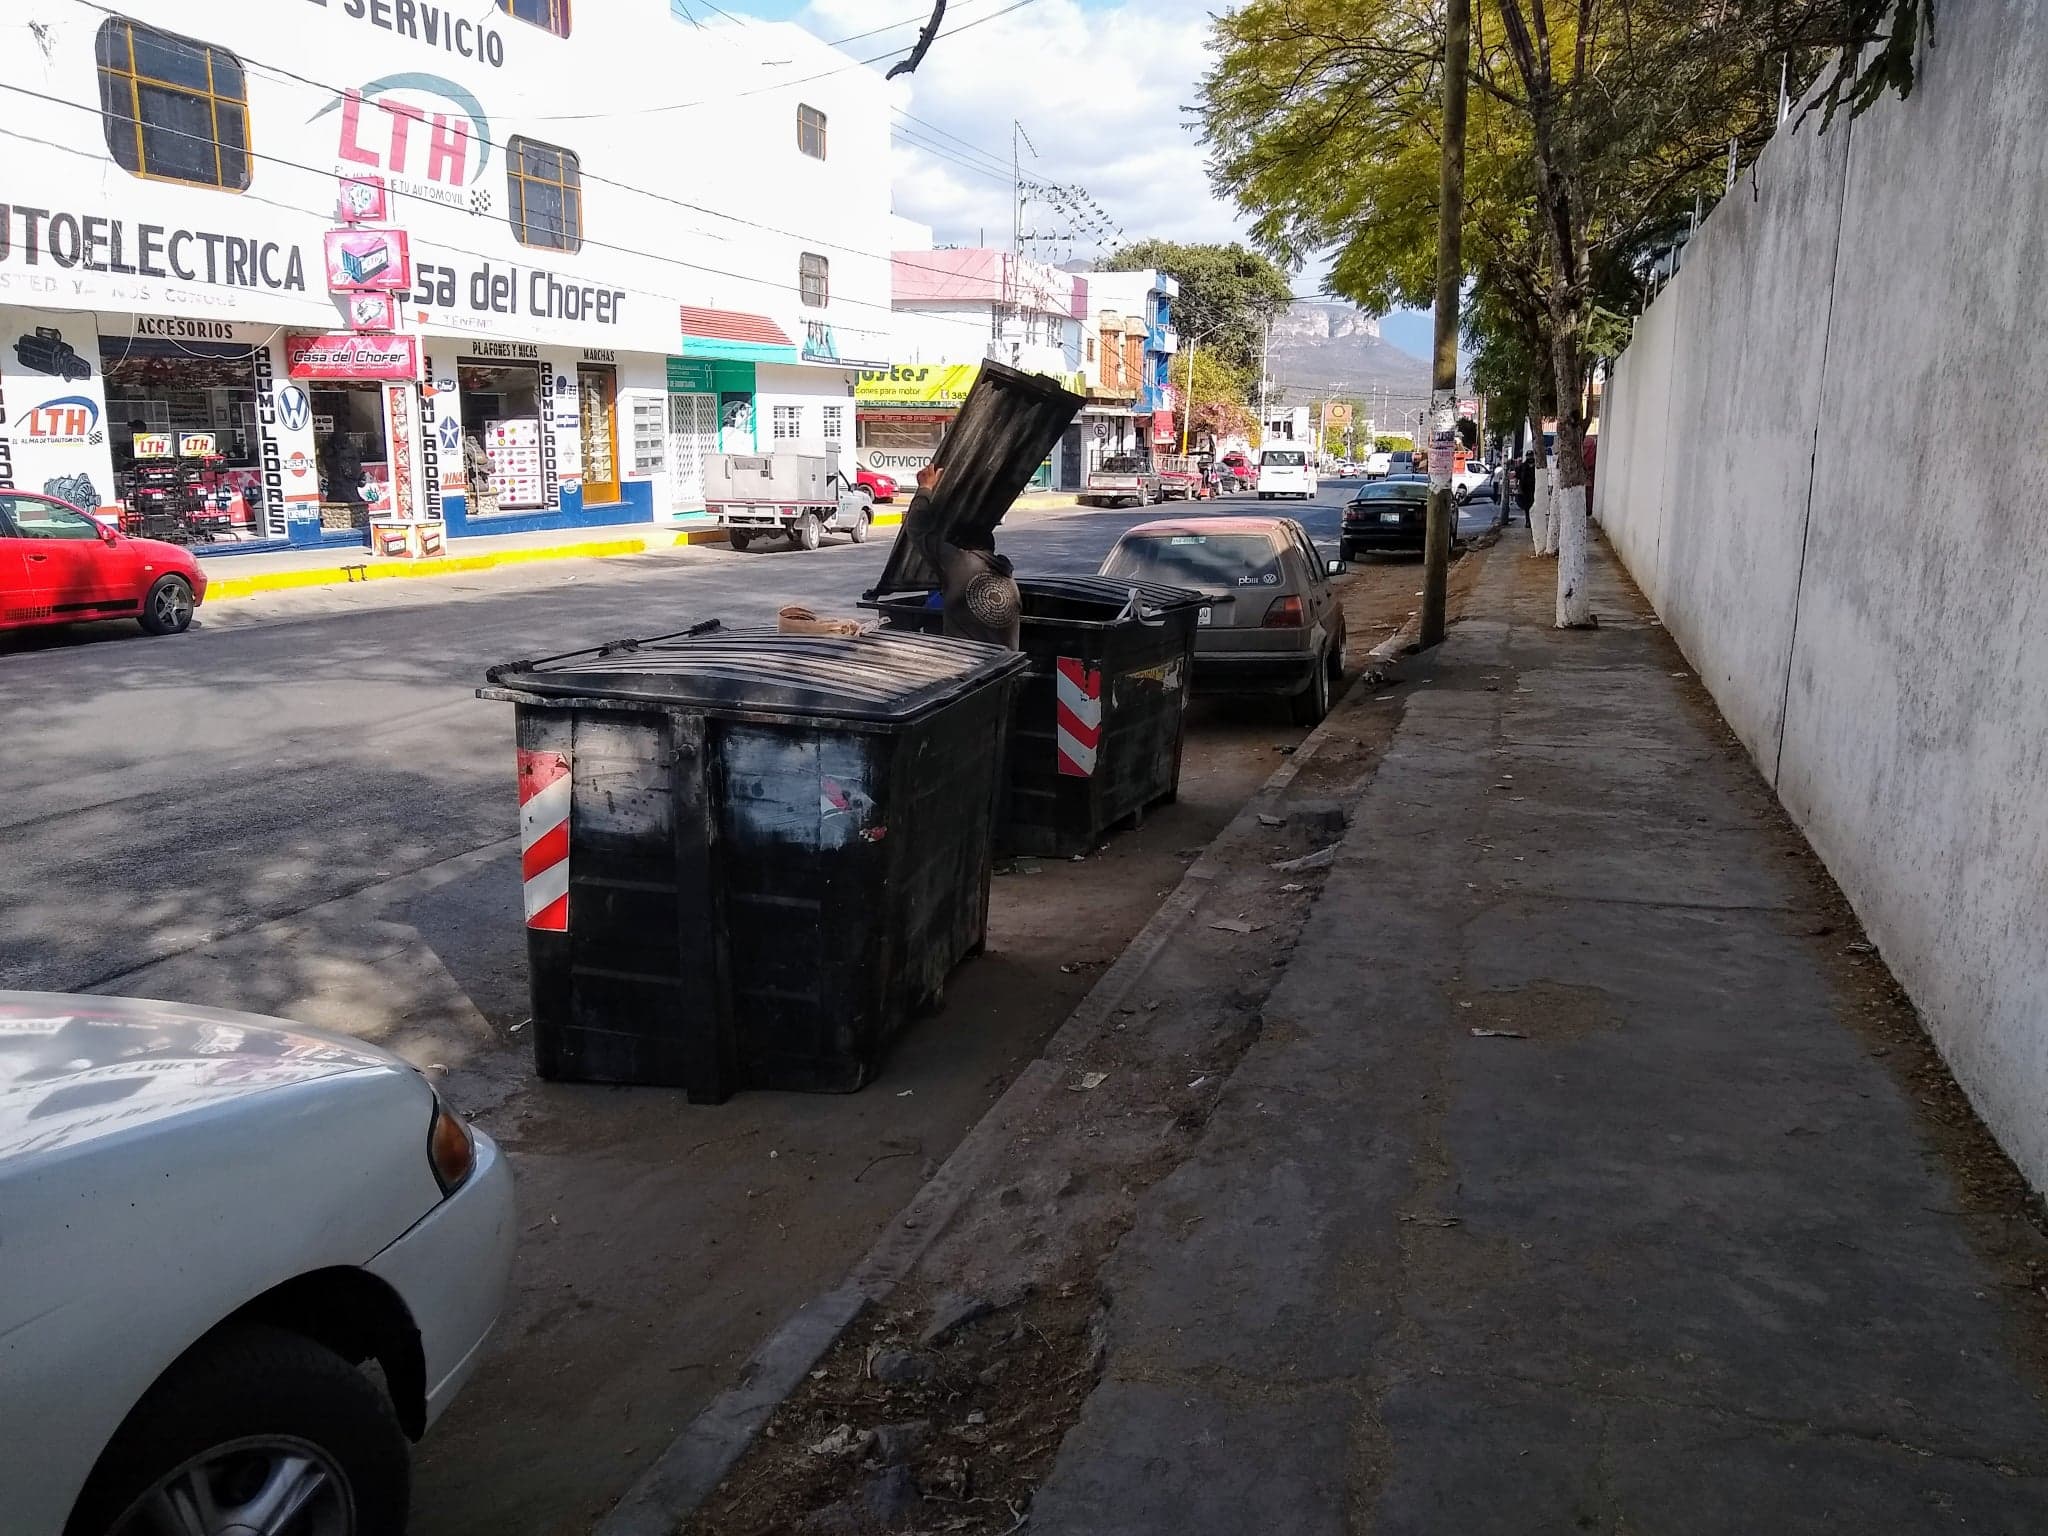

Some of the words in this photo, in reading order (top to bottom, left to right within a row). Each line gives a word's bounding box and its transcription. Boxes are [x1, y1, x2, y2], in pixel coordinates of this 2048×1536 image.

[338, 88, 469, 187] LTH
[412, 184, 464, 205] AUTOMOVIL
[401, 262, 456, 307] sa
[470, 262, 516, 314] del
[137, 317, 234, 340] ACCESORIOS
[293, 350, 327, 363] Casa
[332, 351, 352, 363] del
[471, 341, 511, 357] PLAFONES
[511, 343, 517, 358] Y
[583, 348, 615, 362] MARCHAS
[880, 388, 897, 396] para
[899, 386, 920, 395] motor
[30, 408, 87, 436] LTH
[185, 439, 209, 450] LTH
[254, 345, 287, 535] ACUMULADORES
[541, 362, 559, 508] ACUMULADORES
[139, 440, 165, 453] LTH
[281, 459, 317, 470] NISSAN
